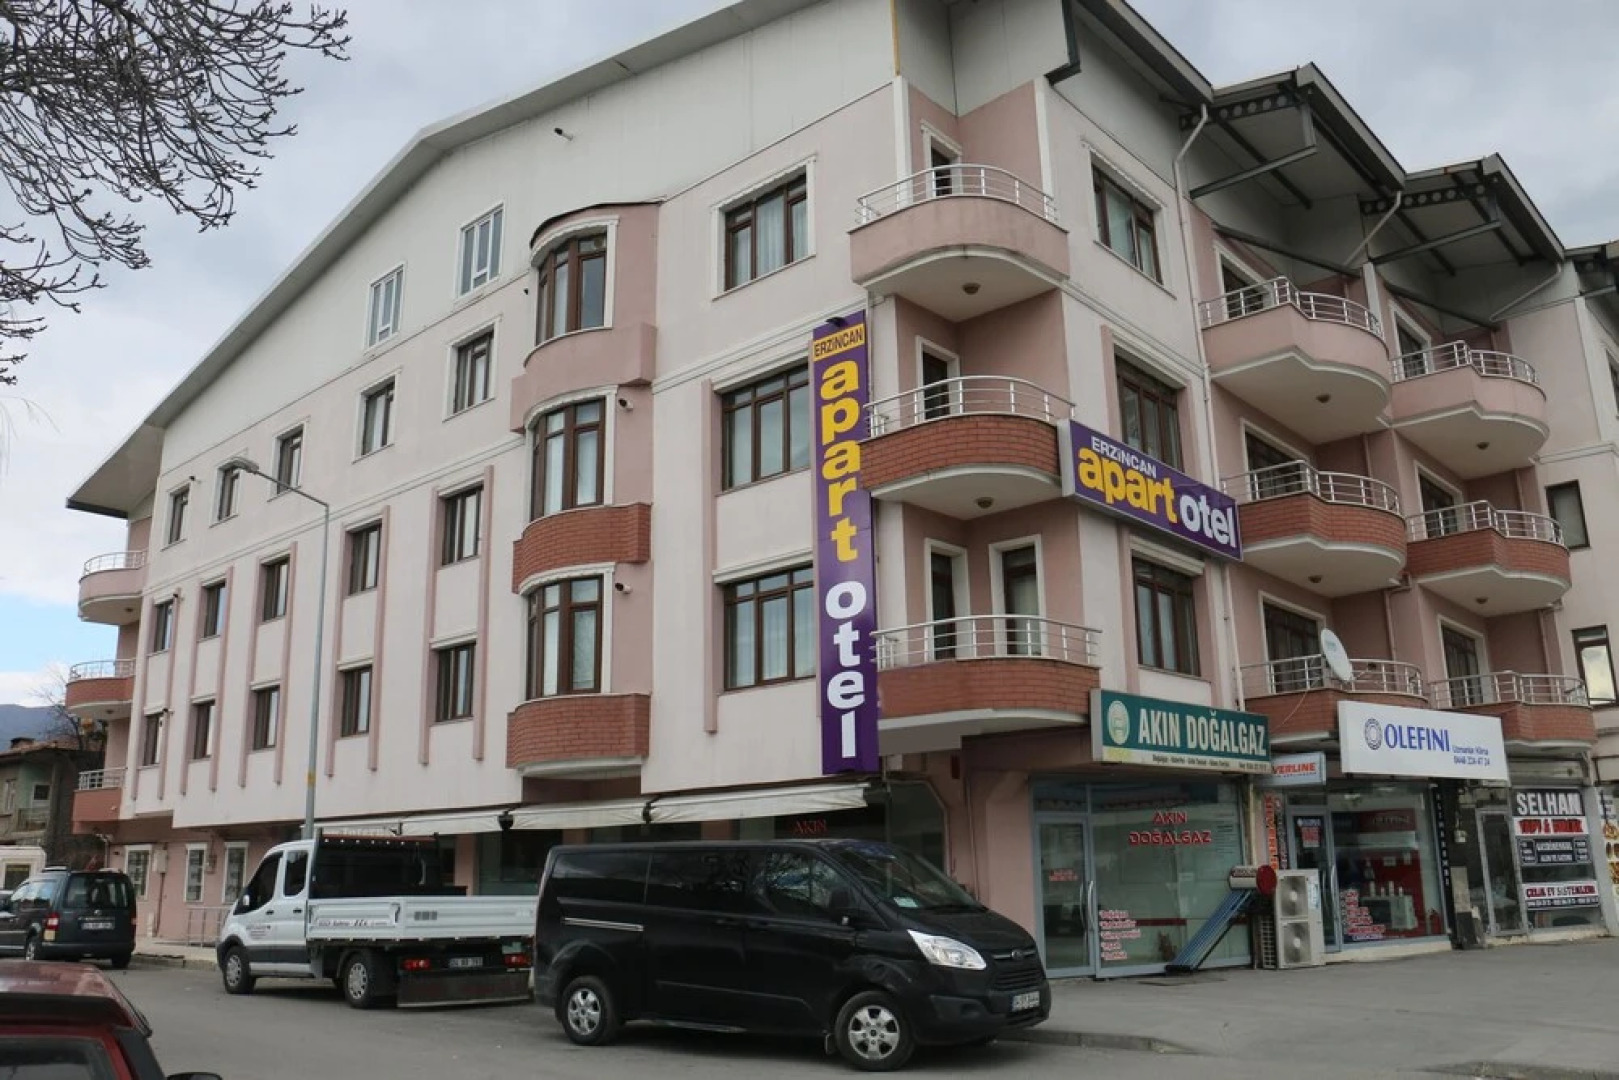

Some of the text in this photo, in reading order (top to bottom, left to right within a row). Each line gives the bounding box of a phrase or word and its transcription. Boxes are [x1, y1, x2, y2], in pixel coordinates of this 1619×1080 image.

[1078, 447, 1238, 548] apart otel
[821, 360, 866, 758] apart otel
[1138, 708, 1267, 756] AKIN DOĞALGAZ
[1384, 723, 1450, 752] OLEFINI
[1153, 811, 1187, 825] AKIN
